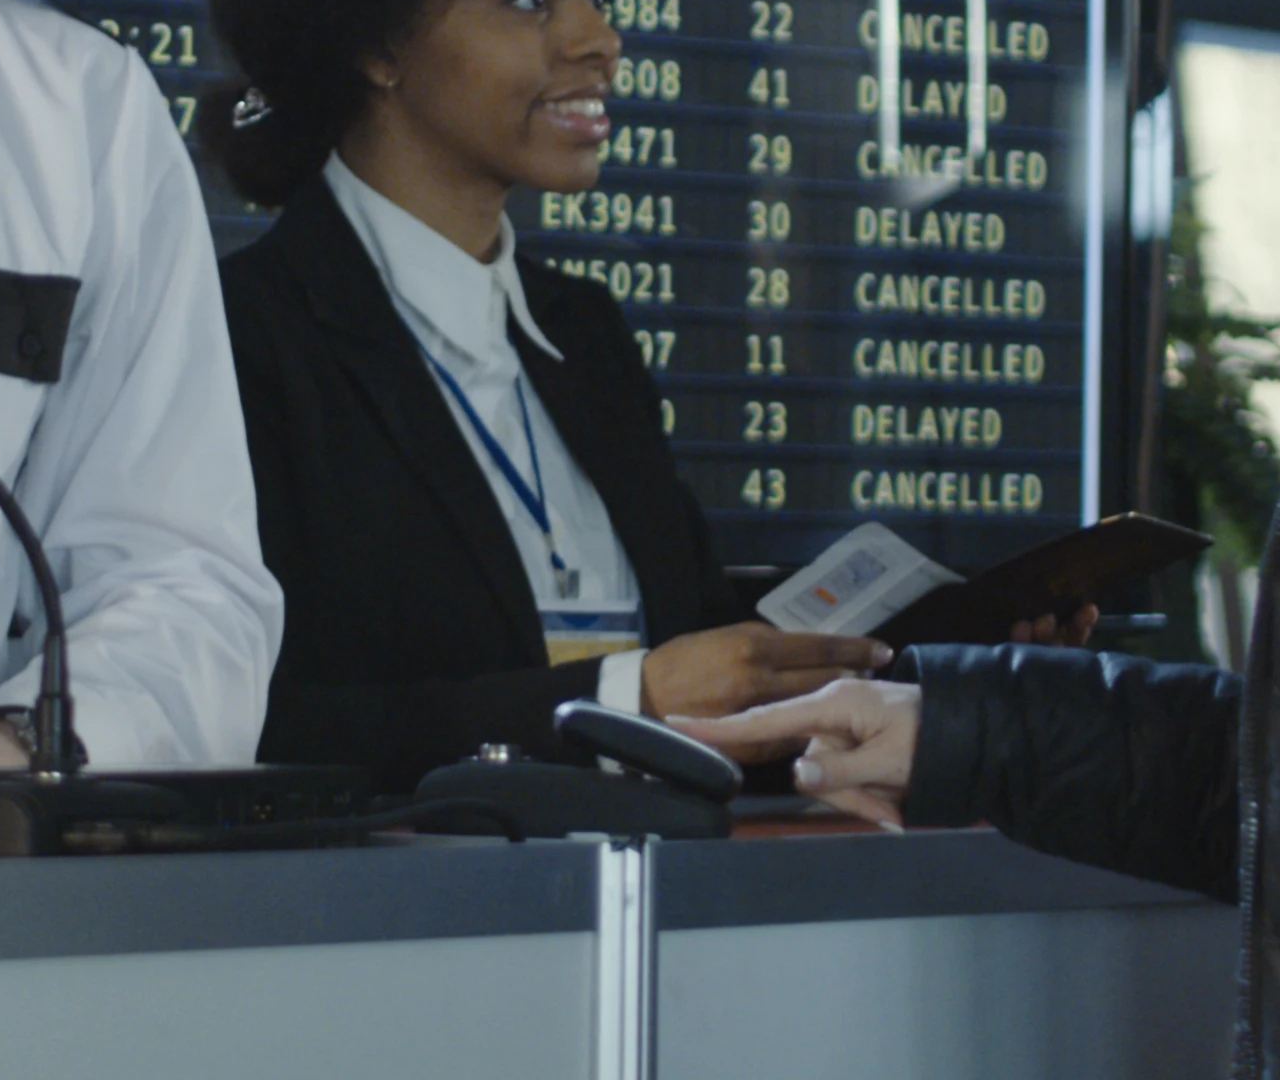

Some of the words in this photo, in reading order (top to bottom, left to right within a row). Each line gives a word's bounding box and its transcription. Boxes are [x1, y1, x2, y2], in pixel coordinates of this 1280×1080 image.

[751, 1, 793, 42] 22
[859, 9, 1049, 62] CNCELED
[100, 18, 197, 65] :21
[613, 57, 681, 101] 608
[749, 69, 790, 108] 41
[857, 74, 1007, 123] DLAYD
[749, 134, 791, 174] 29
[857, 140, 1047, 191] CANCELLED
[541, 191, 677, 236] EK3941
[748, 201, 790, 241] 30
[855, 206, 1006, 253] DELAYED
[746, 268, 789, 308] 28
[855, 272, 1046, 319] CANCELLED
[746, 335, 787, 375] 11
[854, 338, 1045, 383] CANCELLED
[744, 401, 787, 443] 23
[852, 404, 1002, 447] DELAYED
[742, 468, 787, 510] 43
[852, 470, 1043, 513] CANCELLED
